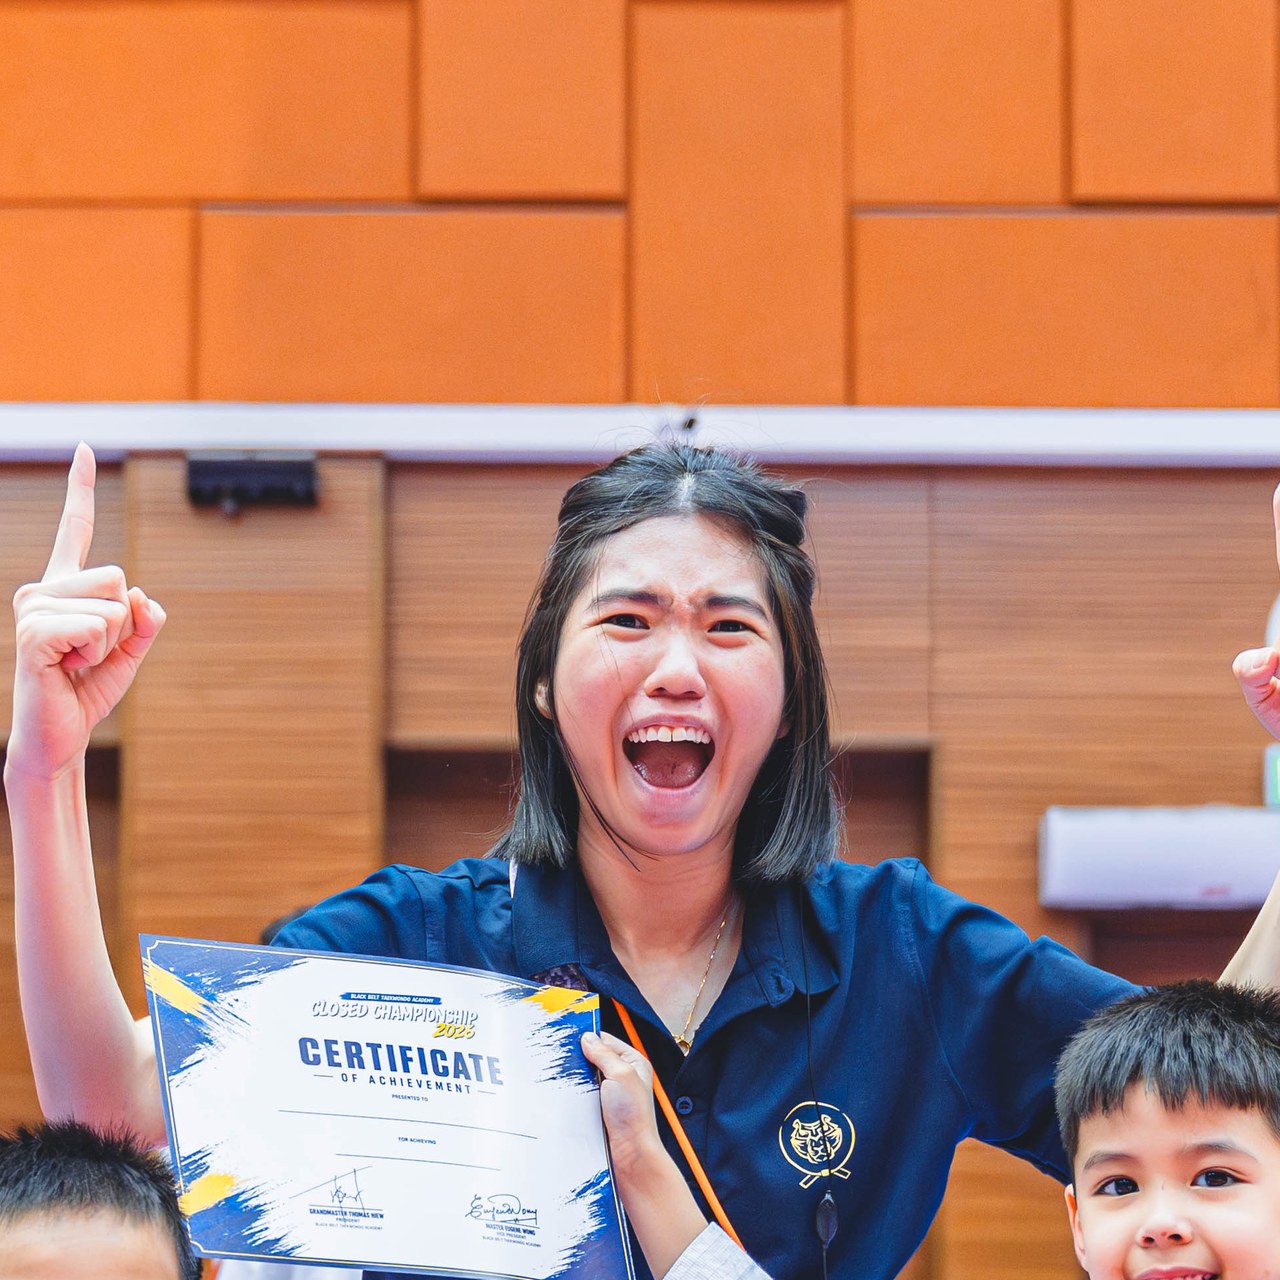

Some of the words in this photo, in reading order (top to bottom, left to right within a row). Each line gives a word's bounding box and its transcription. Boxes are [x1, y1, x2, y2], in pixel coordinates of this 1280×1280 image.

[312, 1000, 369, 1018] CLOSED
[374, 1005, 478, 1026] CHAMPIONSHIP
[432, 1022, 476, 1039] 2026
[298, 1037, 504, 1086] CERTIFICATE
[341, 1072, 358, 1083] OF
[369, 1075, 471, 1095] ACHIEVEMENT
